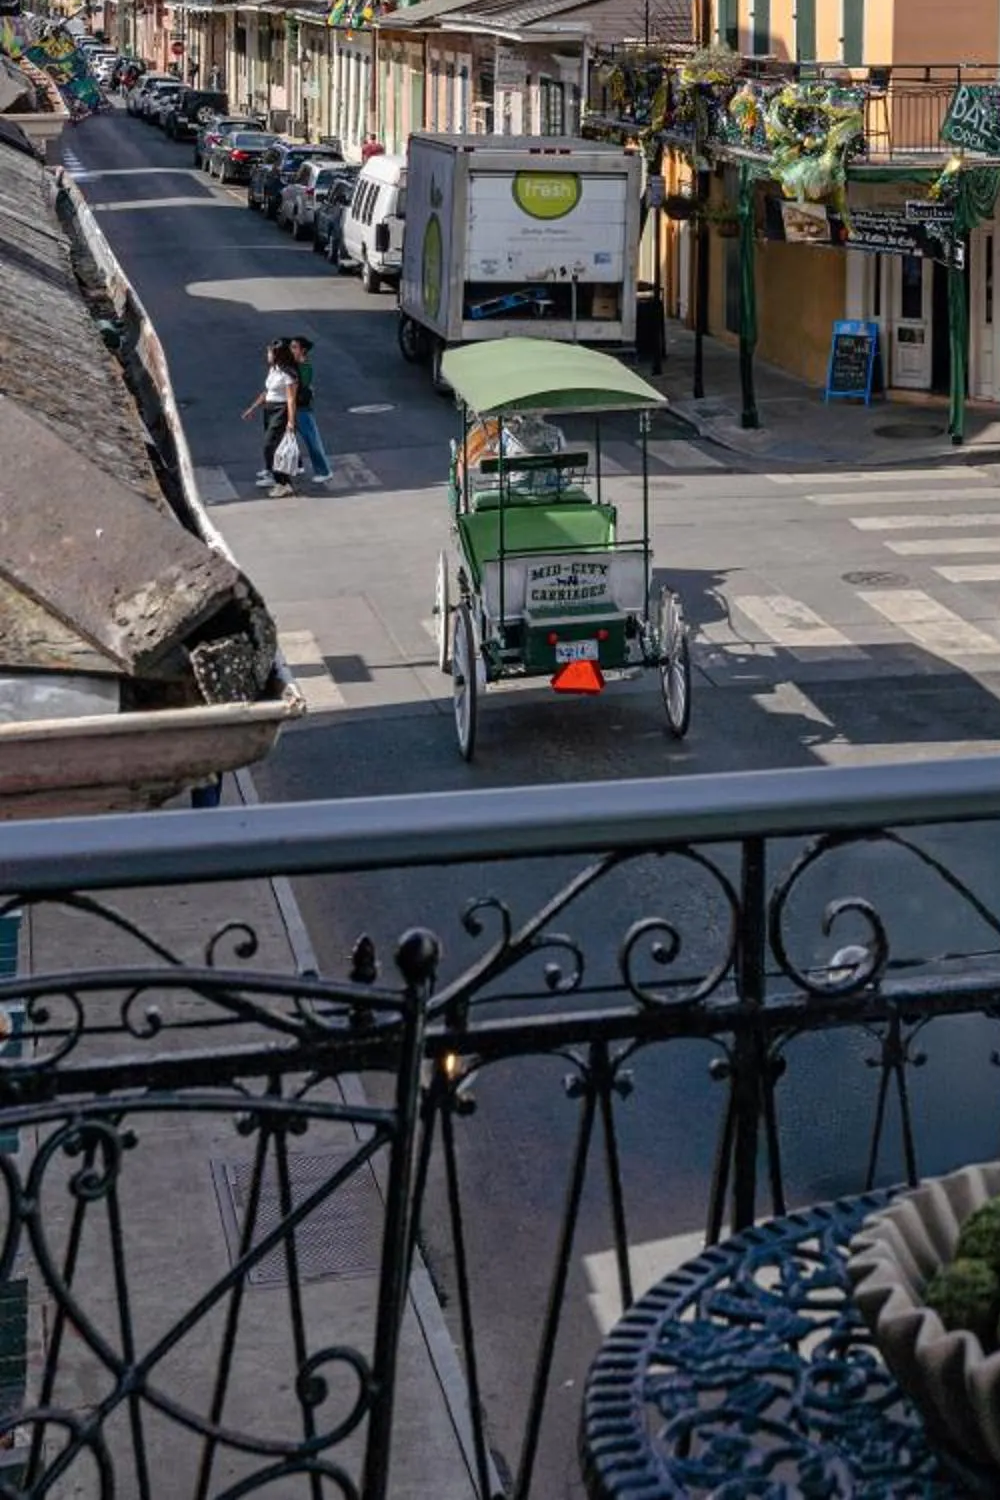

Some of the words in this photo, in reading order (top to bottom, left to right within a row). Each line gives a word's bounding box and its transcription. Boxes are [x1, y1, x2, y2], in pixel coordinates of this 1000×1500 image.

[951, 126, 985, 148] OPEN
[525, 180, 571, 198] fresh
[531, 563, 608, 580] MID-CITY
